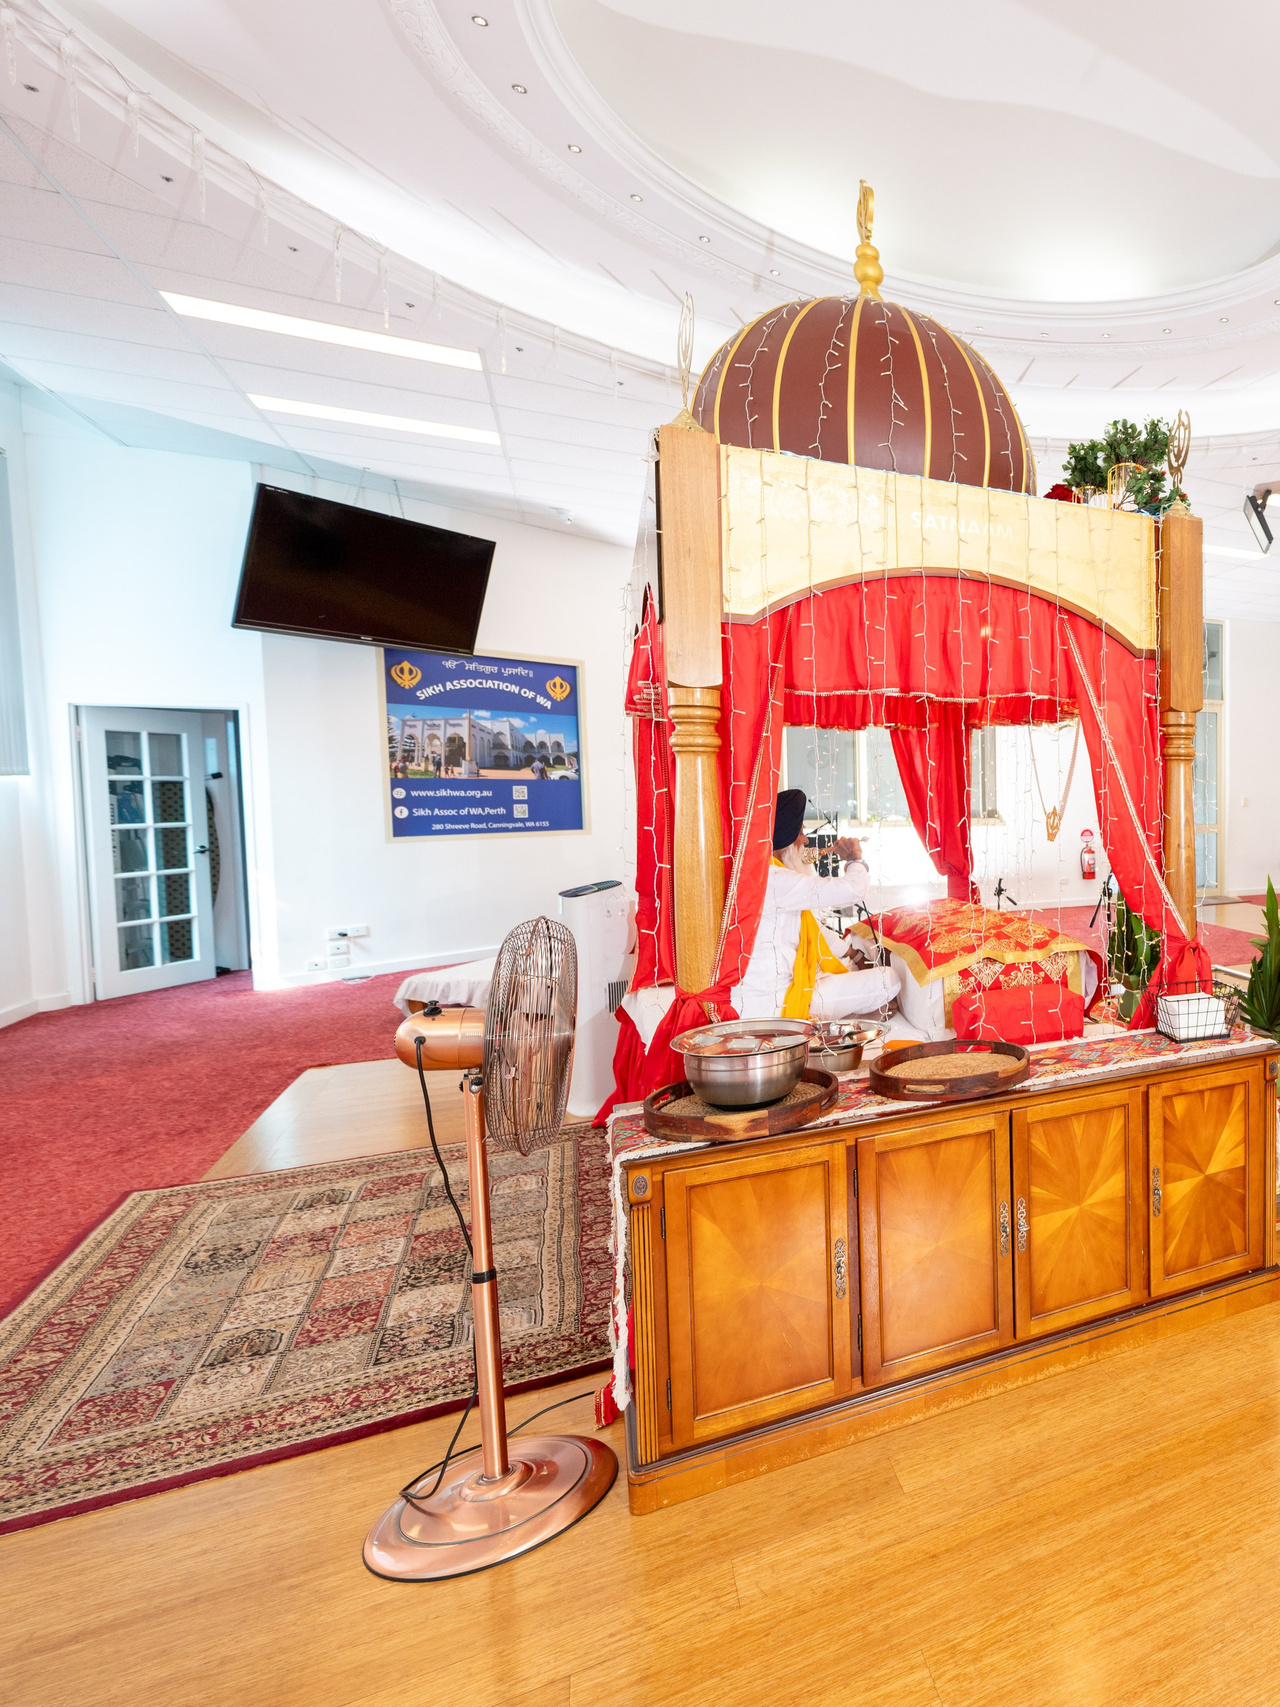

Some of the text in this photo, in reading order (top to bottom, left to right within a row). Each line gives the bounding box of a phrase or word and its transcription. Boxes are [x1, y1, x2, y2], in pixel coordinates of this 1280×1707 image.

[911, 511, 1014, 540] SATNAAM
[416, 678, 552, 710] SIKH ASSOCIATION OF WA
[410, 788, 493, 798] www.sikhwa.org.au
[412, 807, 506, 817] Sikh Assoc of WA,Perth
